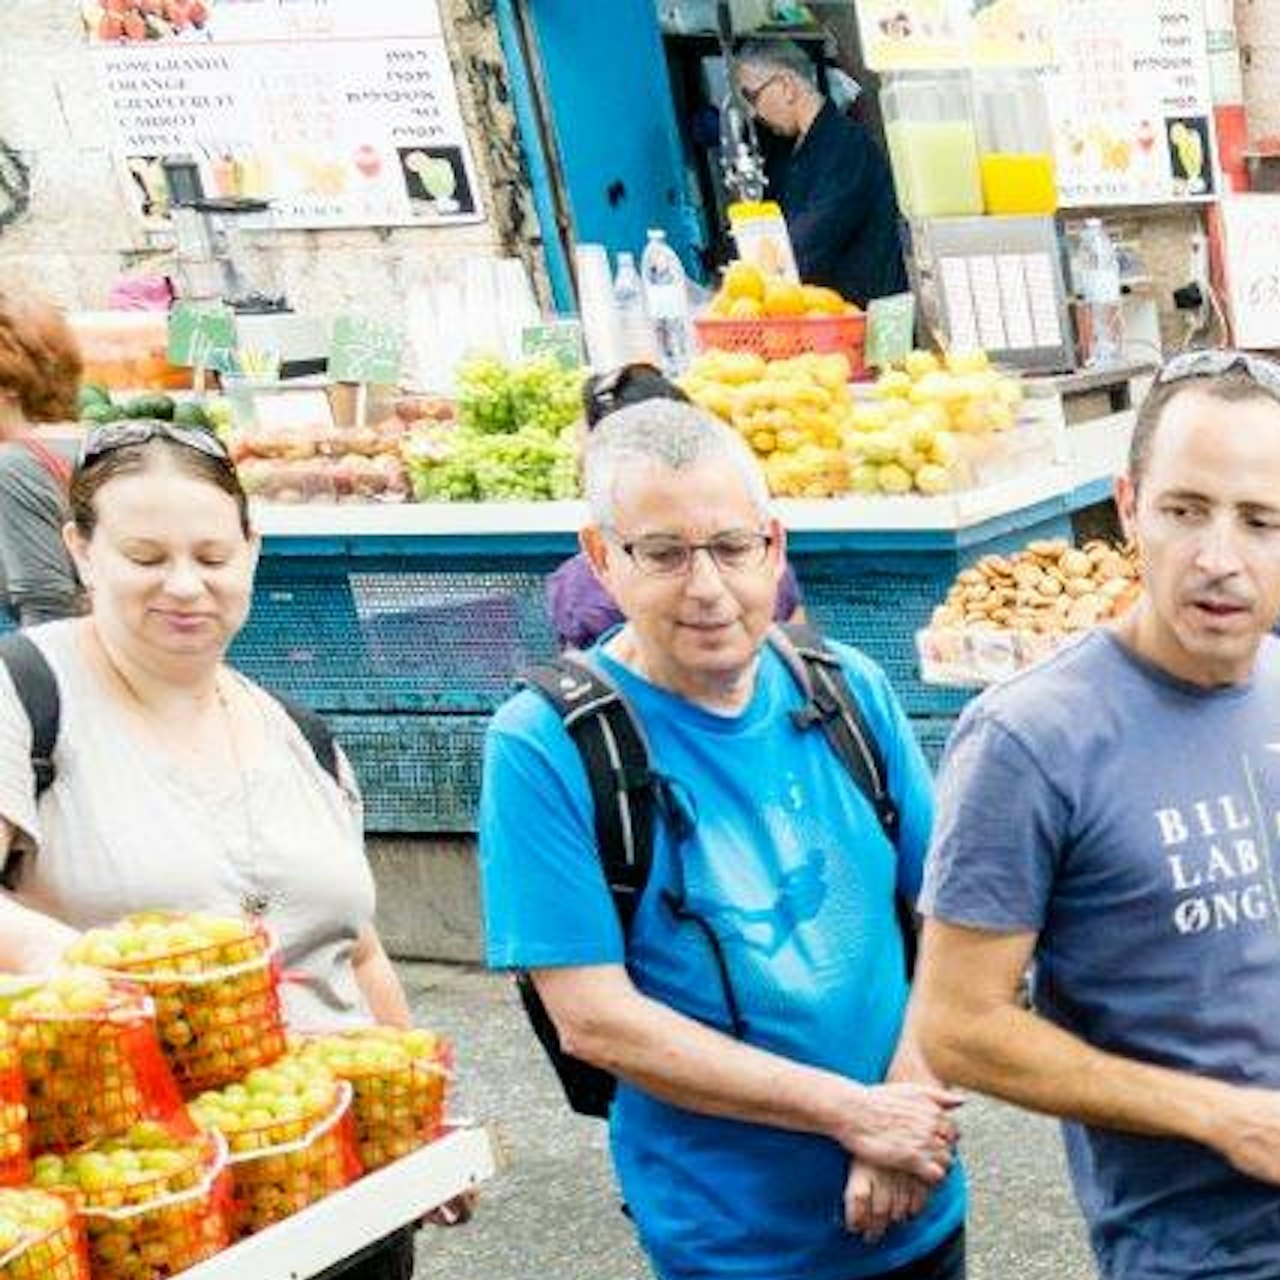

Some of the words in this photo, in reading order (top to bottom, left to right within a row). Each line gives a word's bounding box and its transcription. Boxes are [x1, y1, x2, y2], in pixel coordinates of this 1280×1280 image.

[107, 78, 189, 92] ORANGE
[1155, 795, 1251, 846] BIL
[1167, 838, 1261, 891] LAB
